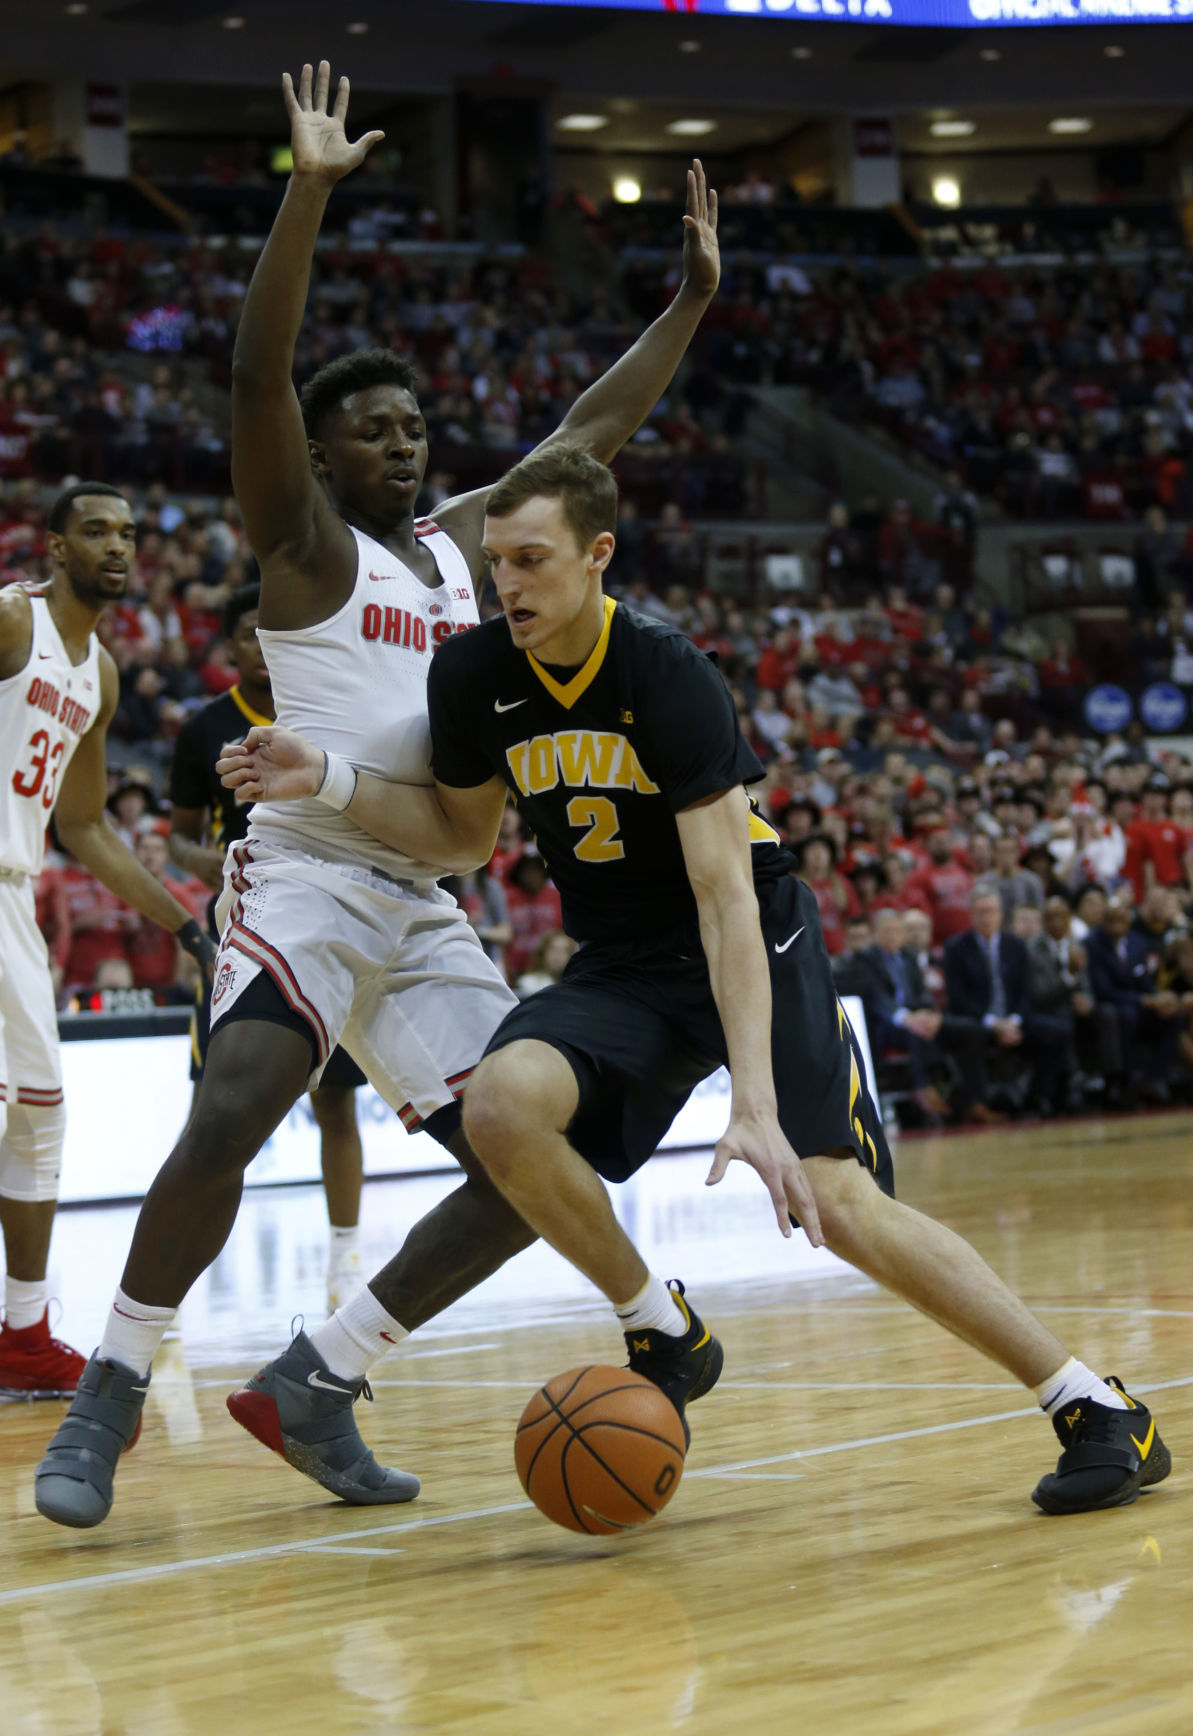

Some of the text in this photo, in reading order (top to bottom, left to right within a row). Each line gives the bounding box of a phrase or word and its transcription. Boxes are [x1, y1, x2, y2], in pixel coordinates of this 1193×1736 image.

[361, 603, 427, 655] OHIO
[27, 677, 60, 717] OHIO
[12, 729, 64, 809] 33
[505, 729, 661, 797] IOWA
[566, 796, 625, 862] 2
